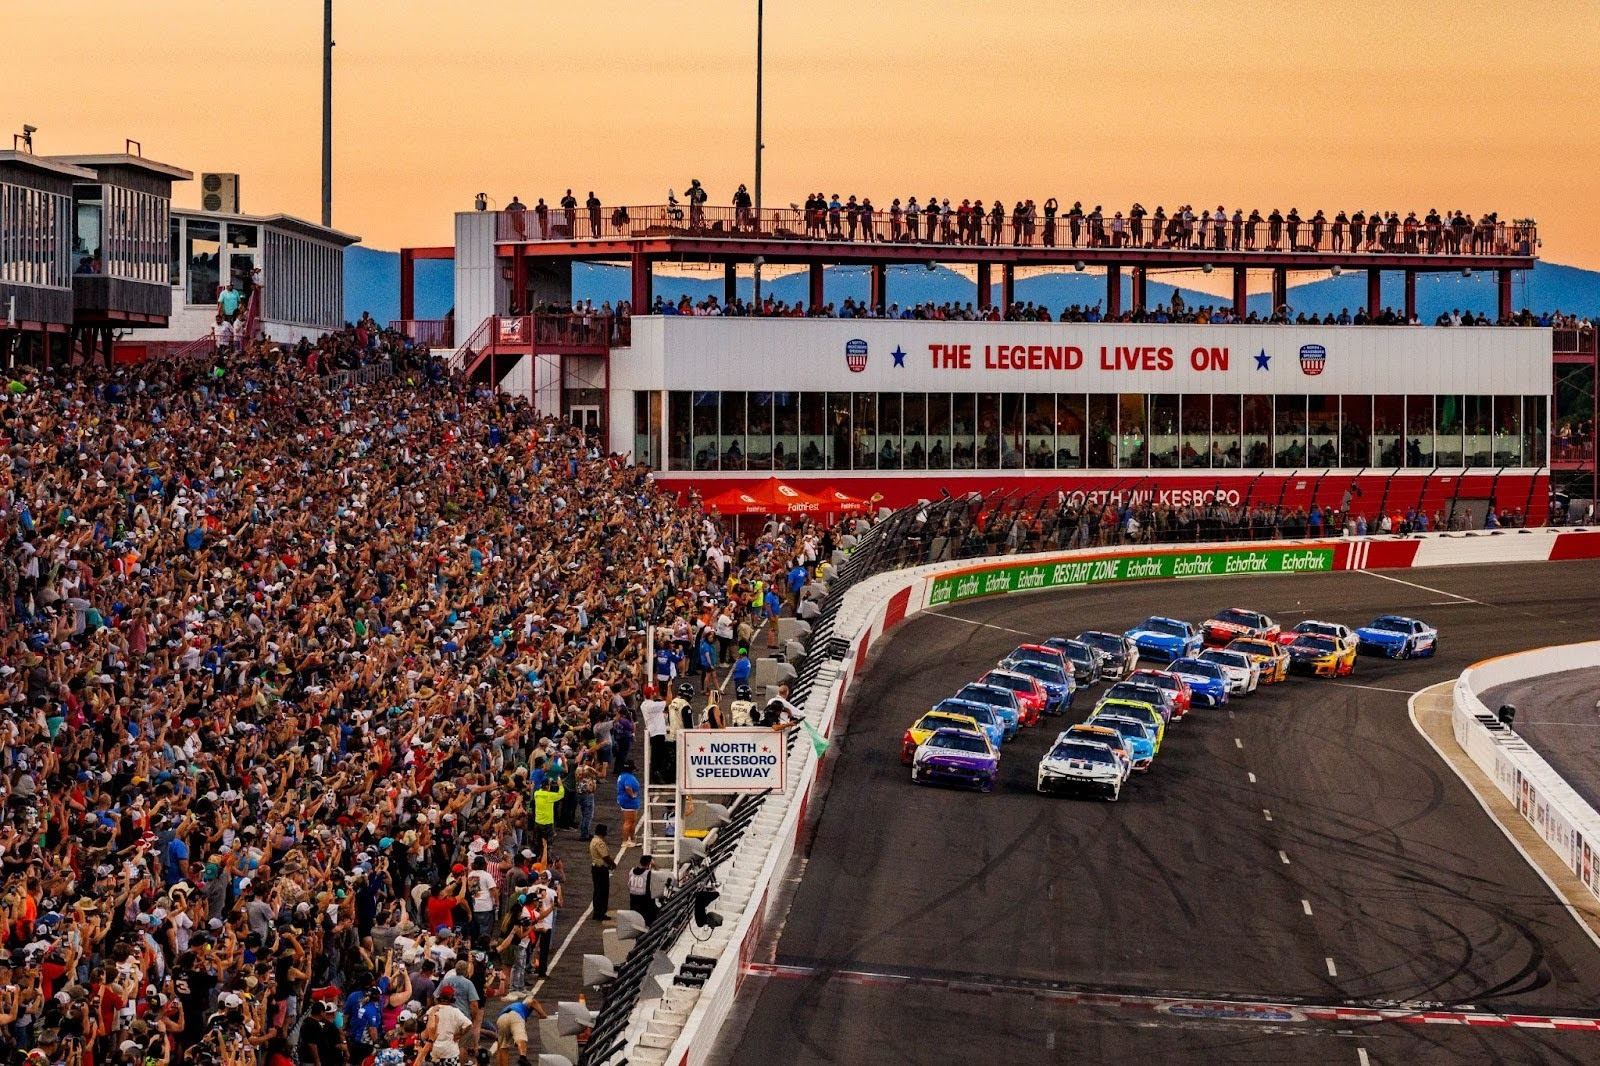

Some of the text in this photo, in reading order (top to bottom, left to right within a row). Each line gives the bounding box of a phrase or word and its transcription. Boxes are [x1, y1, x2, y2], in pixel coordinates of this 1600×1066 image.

[928, 344, 1230, 372] THE LEGEND LIVES ON
[787, 502, 820, 512] FaithFest
[957, 575, 979, 598] EchoPark
[985, 570, 1011, 592] EchoPark
[1017, 566, 1045, 589] EchoPark
[1052, 562, 1093, 584] RESTART
[1092, 559, 1121, 580] ZONE
[1126, 557, 1162, 577] EchoPark
[1173, 554, 1213, 575] EchoPark
[1225, 552, 1268, 573] EchoPark
[1281, 550, 1325, 570] EchoPark
[710, 743, 757, 753] NORTH
[690, 755, 777, 766] WILKESBORO
[696, 767, 771, 778] SPEEDWAY
[176, 979, 191, 995] 3
